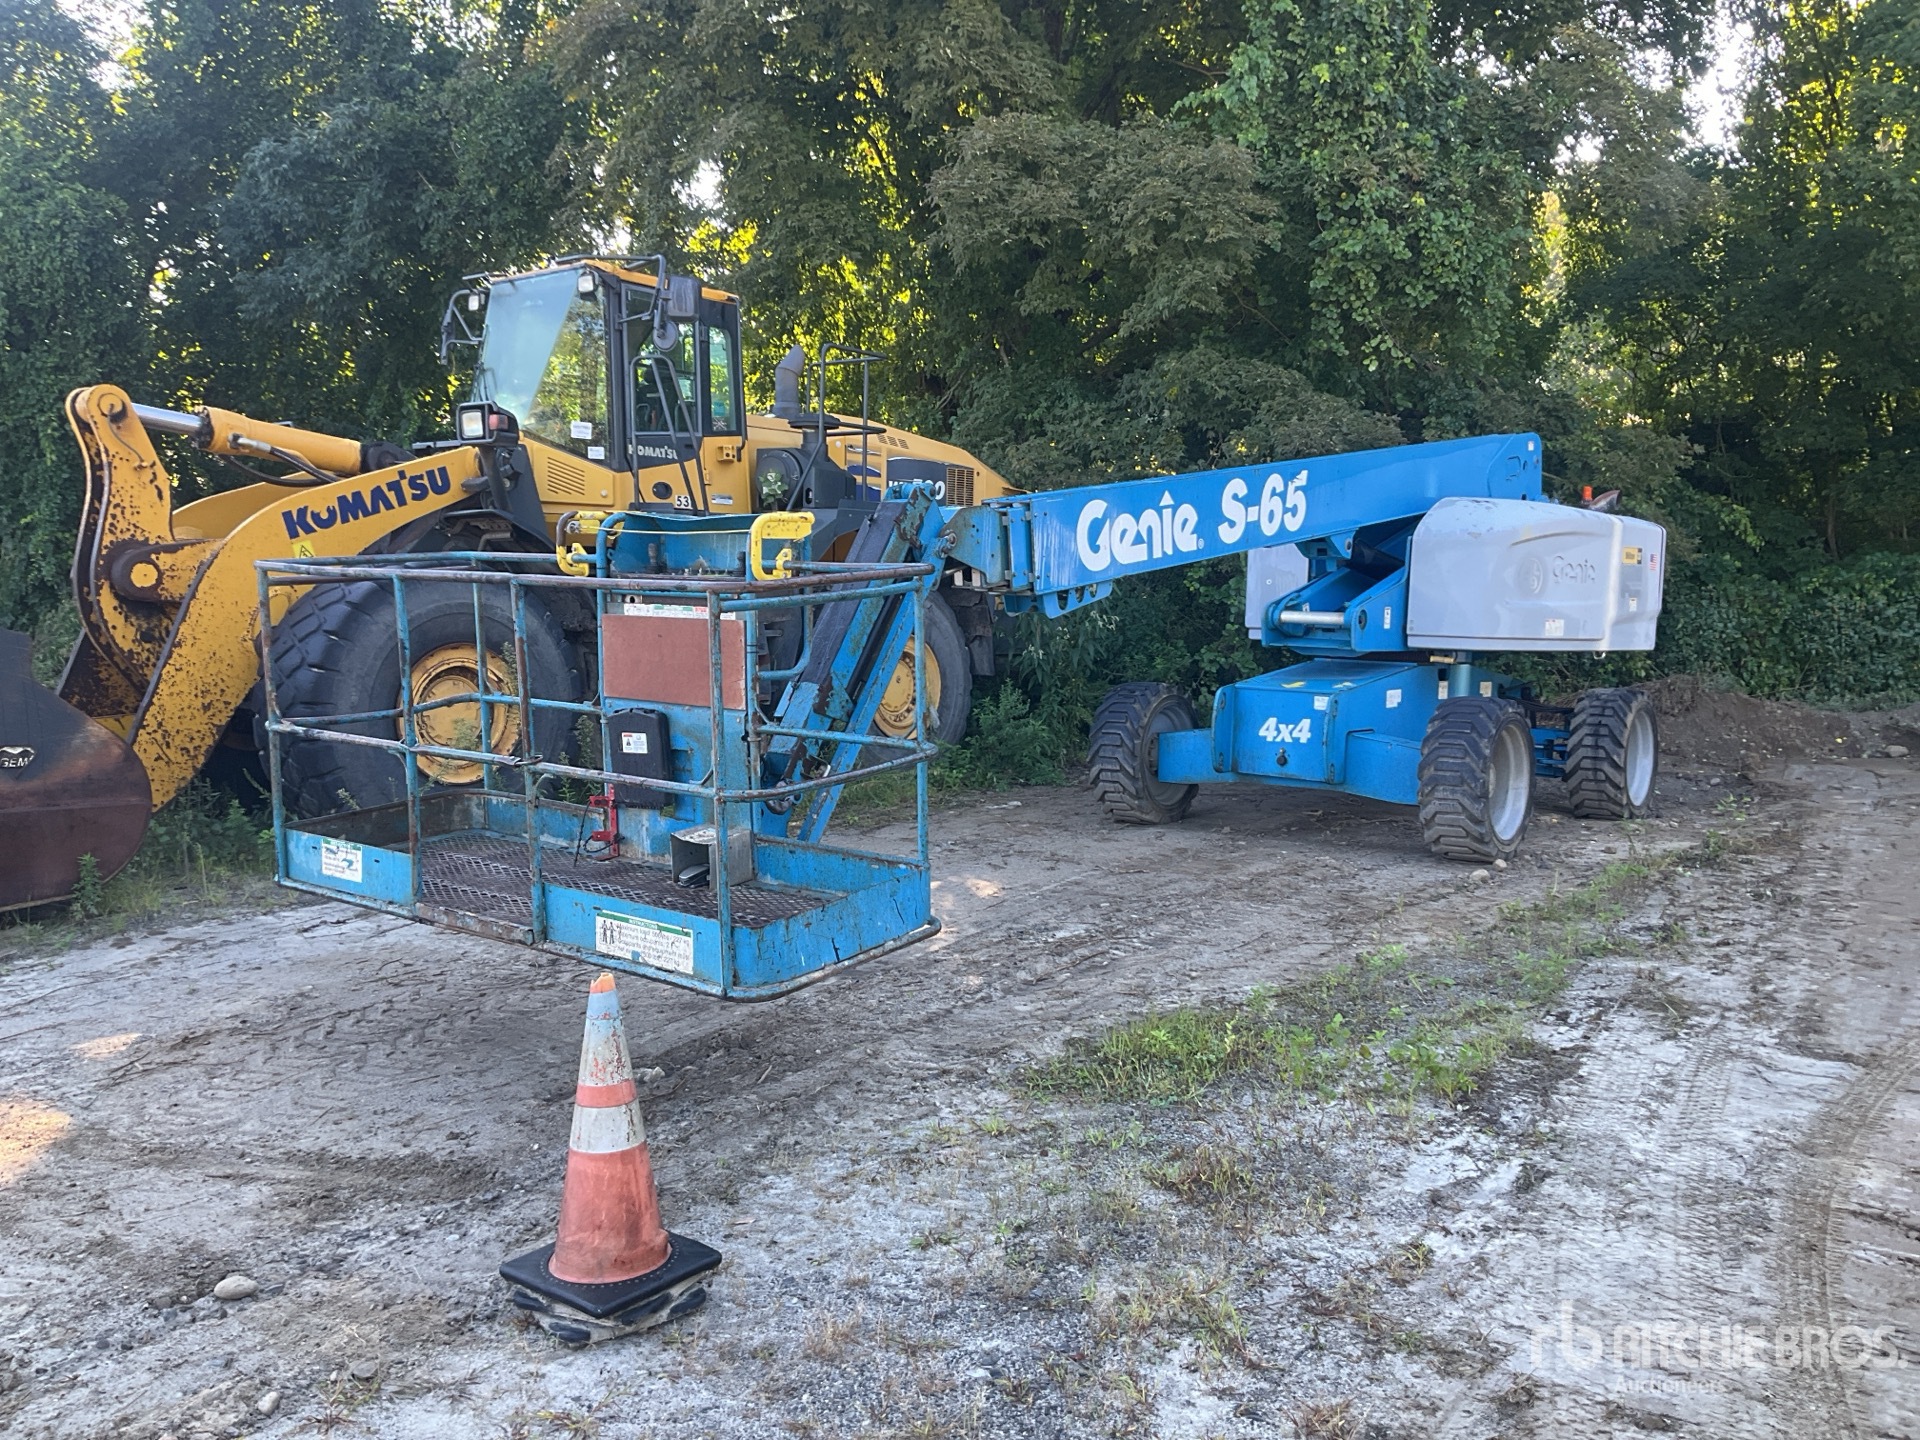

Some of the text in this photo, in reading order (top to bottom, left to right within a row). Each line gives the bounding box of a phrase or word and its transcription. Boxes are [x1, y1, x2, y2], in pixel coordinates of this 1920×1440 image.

[281, 466, 451, 540] KOMATSU
[1076, 469, 1309, 572] Genie S-65
[1552, 555, 1596, 584] Genie
[1258, 717, 1312, 744] 4x4
